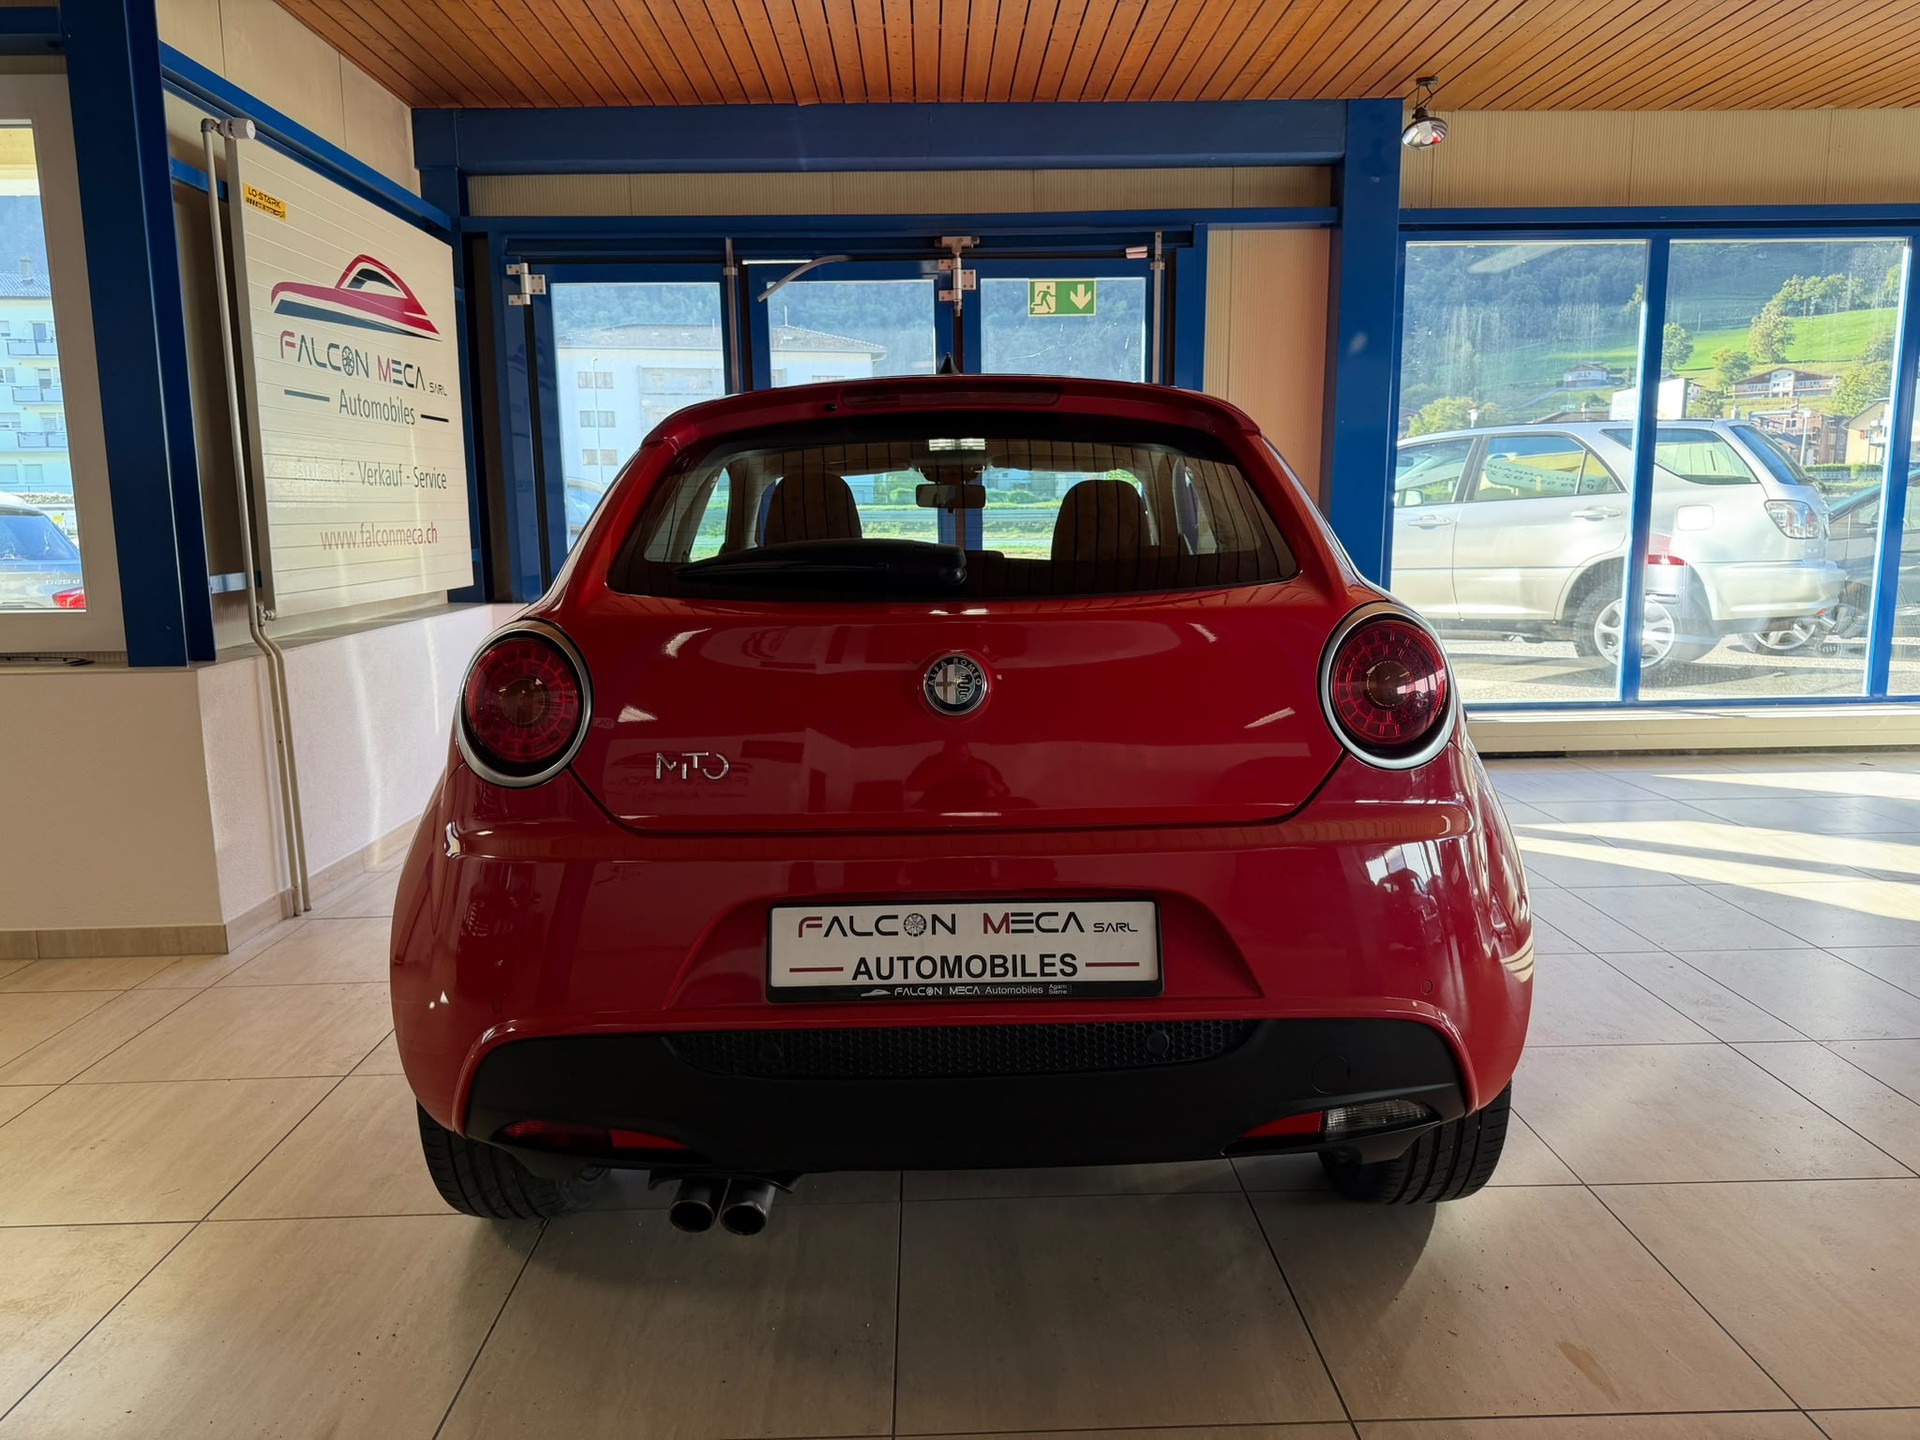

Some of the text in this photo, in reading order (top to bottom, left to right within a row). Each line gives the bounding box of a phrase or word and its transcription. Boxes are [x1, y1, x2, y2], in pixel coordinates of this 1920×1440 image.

[280, 330, 448, 397] FALCON MECA SARL
[339, 388, 416, 425] Automobiles
[357, 461, 403, 487] Verkauf
[413, 467, 447, 490] Service
[320, 522, 438, 550] www.falconmeca.ch
[928, 661, 948, 686] ALFA
[799, 911, 1139, 938] FALCON MECA SARL
[851, 952, 1078, 981] AUTOMOBILES
[894, 985, 1044, 996] FALCON MECA Automobiles
